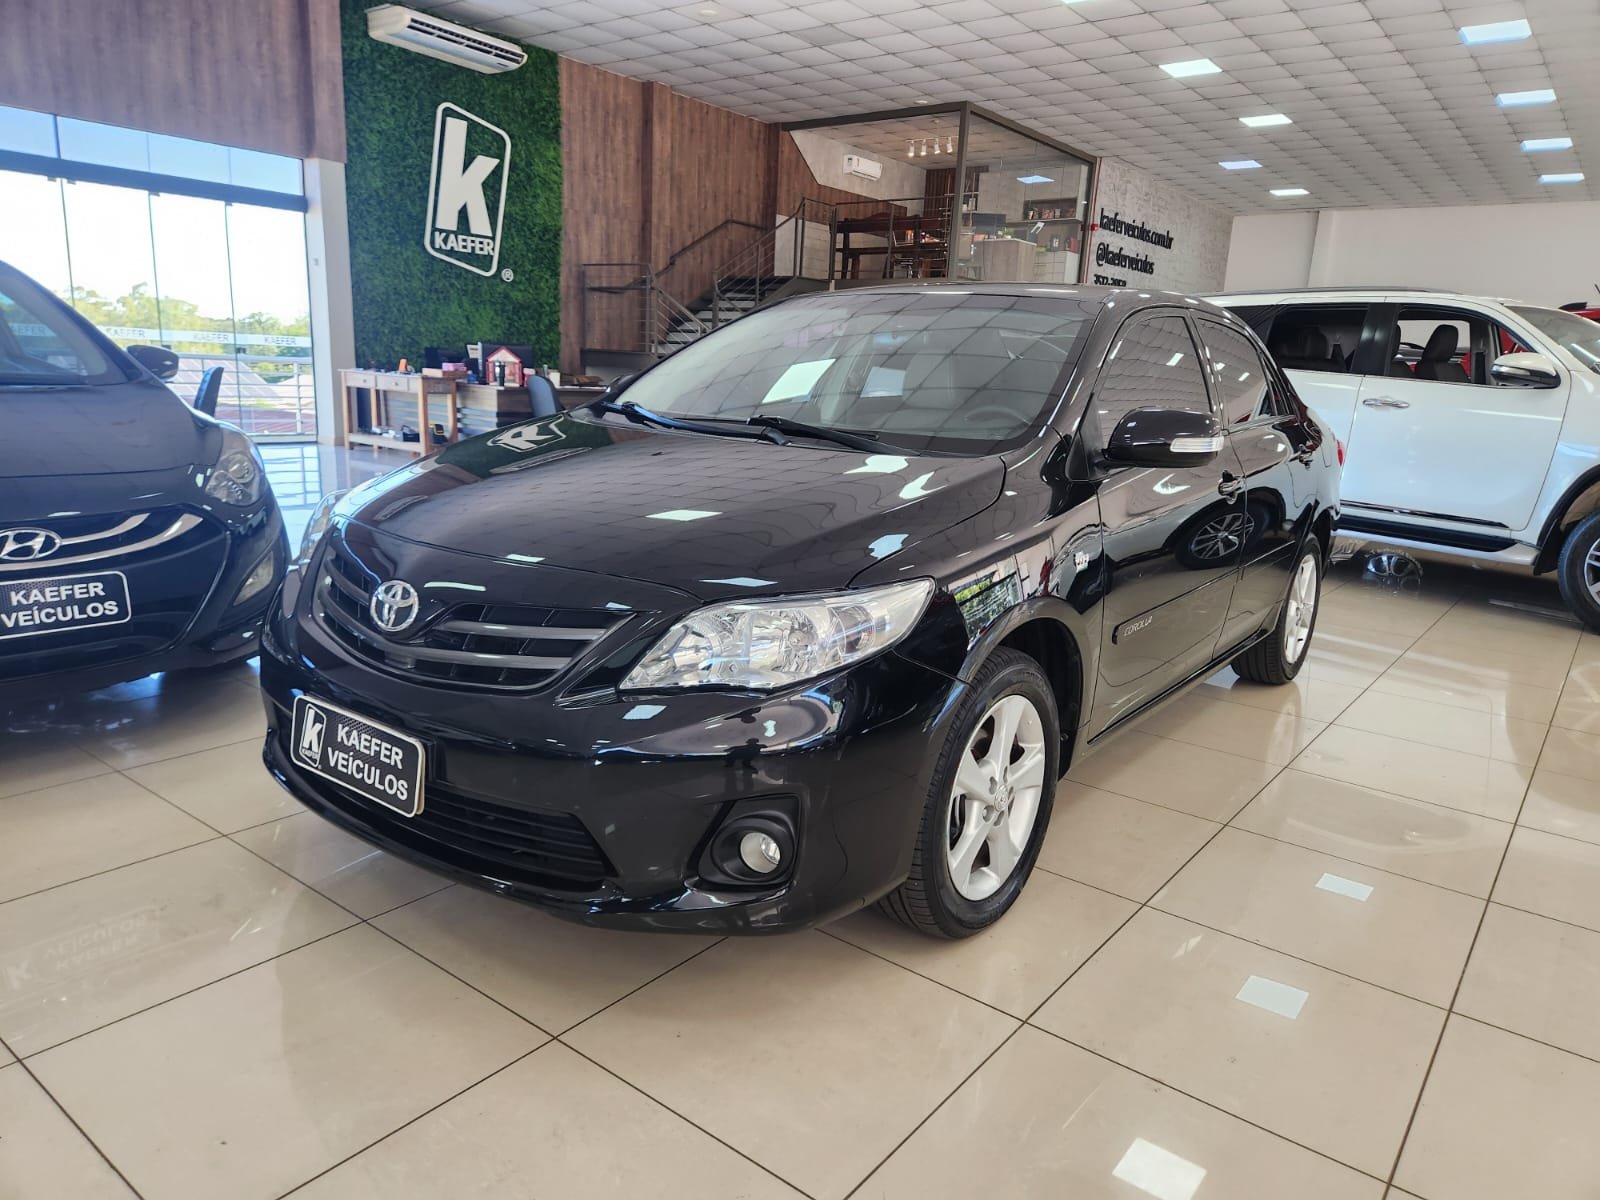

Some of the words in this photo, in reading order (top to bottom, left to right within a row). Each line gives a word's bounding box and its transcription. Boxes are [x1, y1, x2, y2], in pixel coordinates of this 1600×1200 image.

[434, 231, 496, 256] KAEFER
[1096, 242, 1155, 275] @kaeferveiculos
[9, 581, 106, 606] KAEFER
[0, 600, 119, 628] VEÍCULOS
[337, 724, 404, 769] KAEFER
[327, 746, 409, 801] VEÍCULOS
